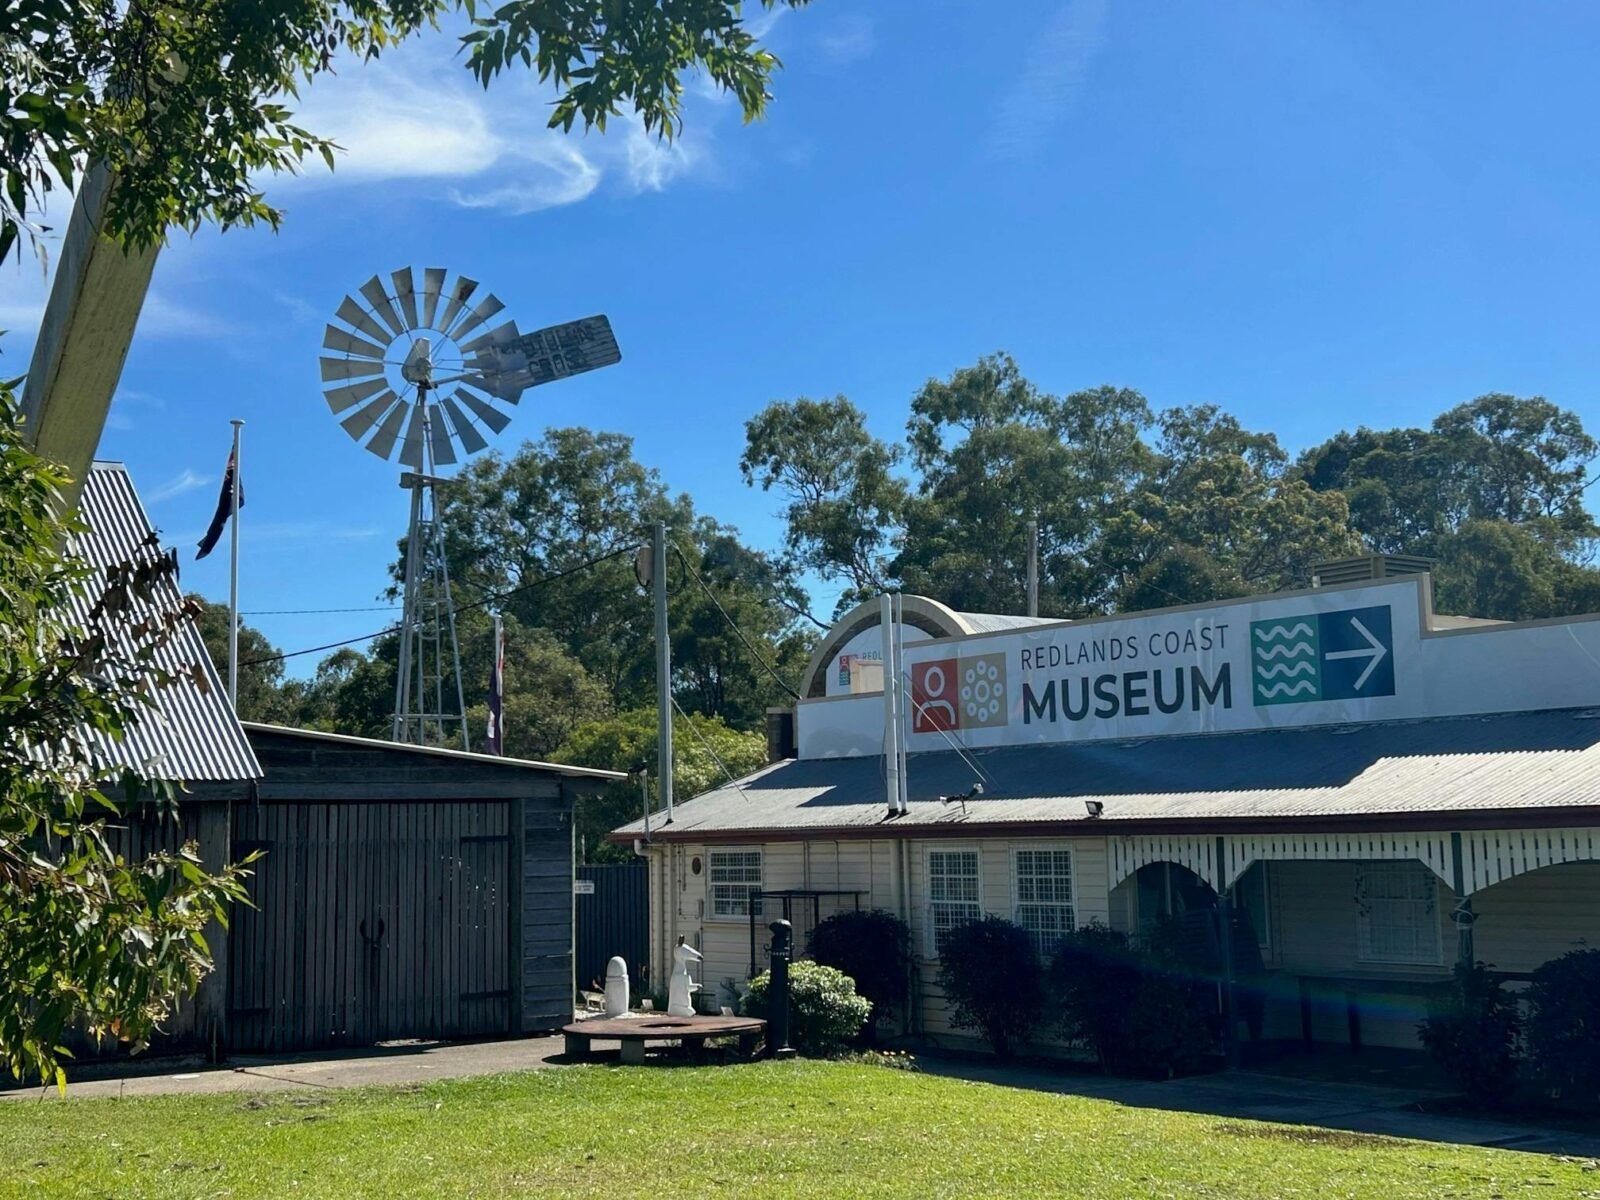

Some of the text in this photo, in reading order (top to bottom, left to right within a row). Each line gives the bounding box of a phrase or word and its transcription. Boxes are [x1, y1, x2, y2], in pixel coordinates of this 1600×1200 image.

[1021, 624, 1229, 670] REDLANDS COAST
[1022, 662, 1232, 725] MUSEUM
